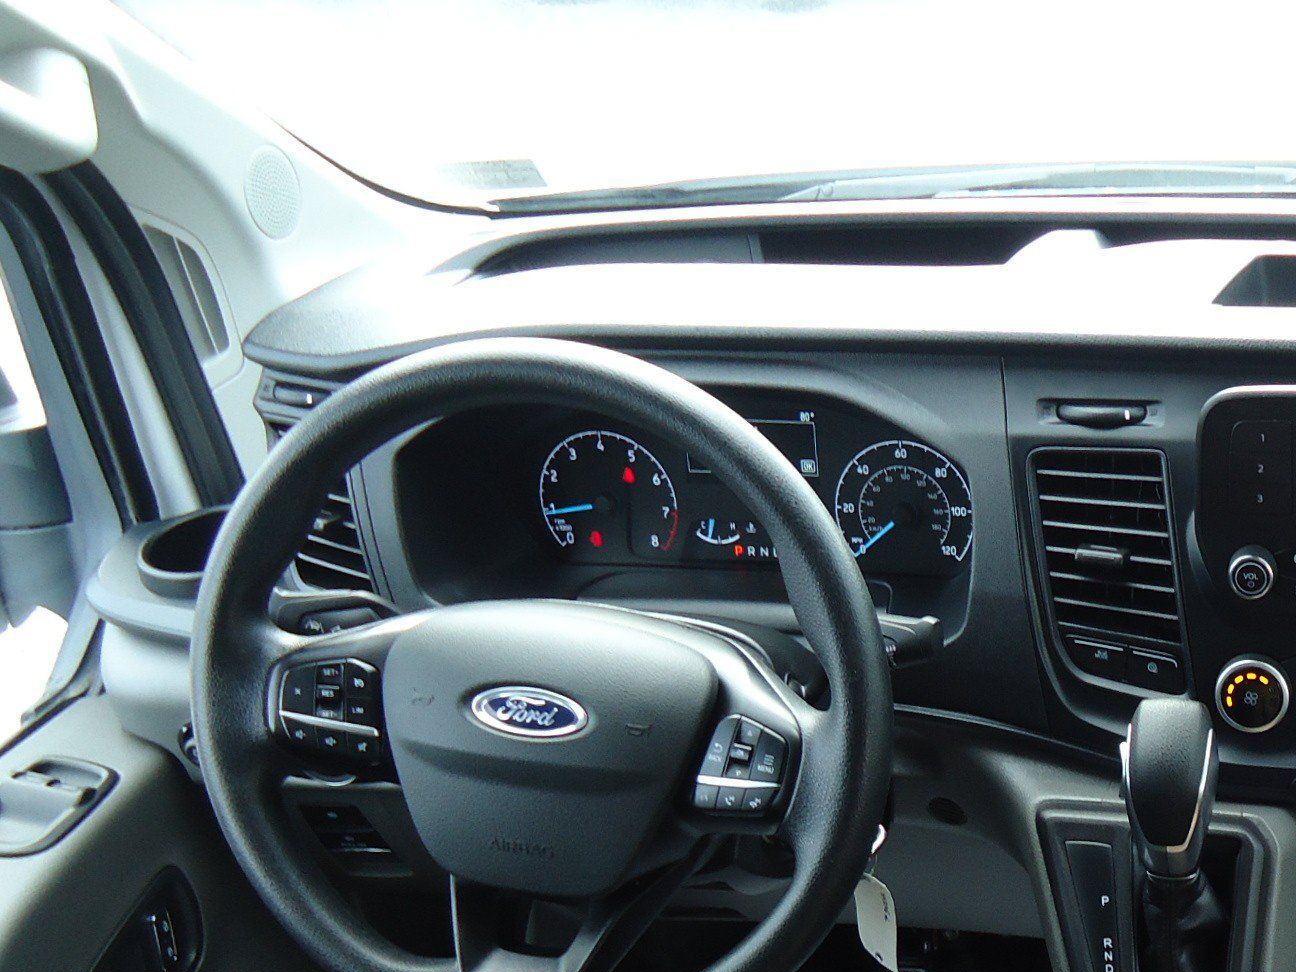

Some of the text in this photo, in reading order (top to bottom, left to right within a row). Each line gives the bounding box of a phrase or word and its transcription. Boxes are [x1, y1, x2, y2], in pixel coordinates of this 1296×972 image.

[1260, 433, 1265, 442] 1
[597, 438, 604, 451] 4
[569, 447, 577, 460] 3
[627, 449, 636, 462] 5
[894, 448, 907, 459] 60
[857, 464, 869, 475] 40
[935, 467, 948, 478] 80
[1257, 464, 1264, 473] 2
[550, 469, 558, 482] 2
[652, 472, 661, 486] 6
[1257, 494, 1264, 503] 3
[662, 505, 670, 519] 7
[842, 502, 855, 513] 20
[950, 506, 967, 517] 100
[566, 531, 575, 544] 0
[651, 534, 660, 547] 8
[734, 545, 744, 556] P
[747, 546, 756, 557] R
[760, 547, 769, 557] N
[941, 545, 957, 556] 120
[1243, 572, 1258, 581] VOL
[496, 697, 559, 726] Ford
[1101, 895, 1110, 907] P
[1103, 938, 1112, 949] R
[1104, 951, 1113, 962] N
